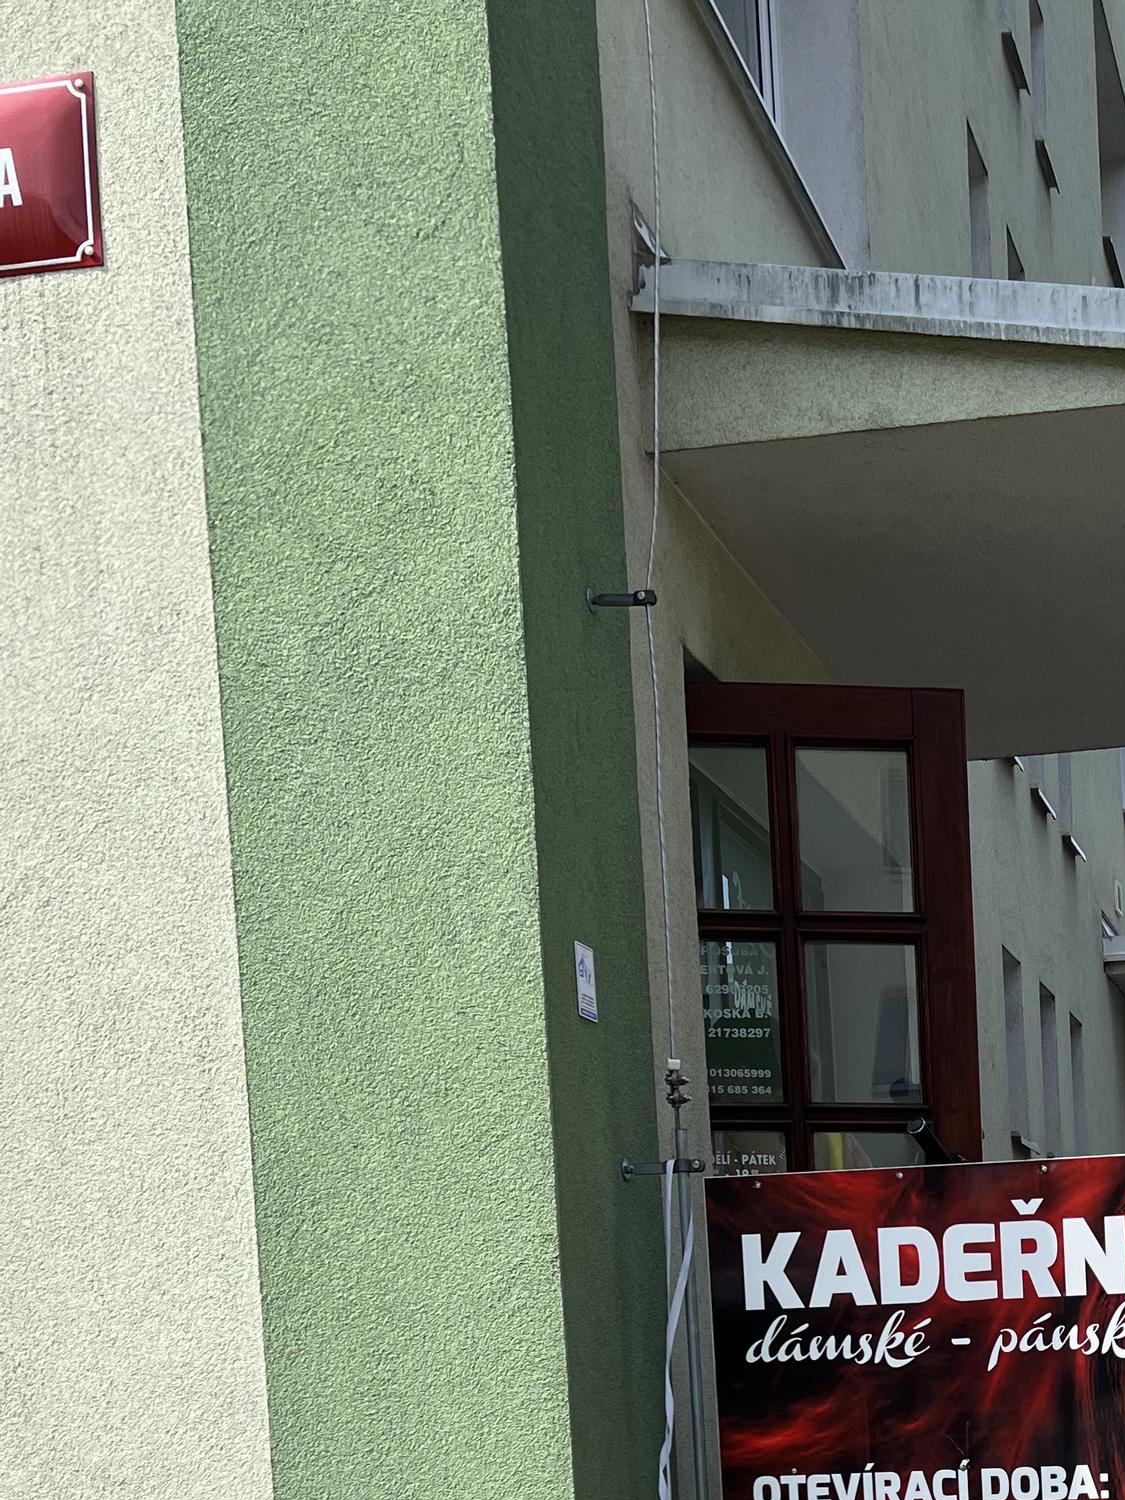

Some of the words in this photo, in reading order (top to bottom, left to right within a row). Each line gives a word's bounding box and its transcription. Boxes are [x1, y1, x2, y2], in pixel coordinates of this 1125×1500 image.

[708, 1027, 771, 1038] 21738297
[727, 1085, 748, 1095] 685
[751, 1085, 772, 1095] 364
[741, 1150, 777, 1166] PÁTEK
[745, 1310, 931, 1368] dámské
